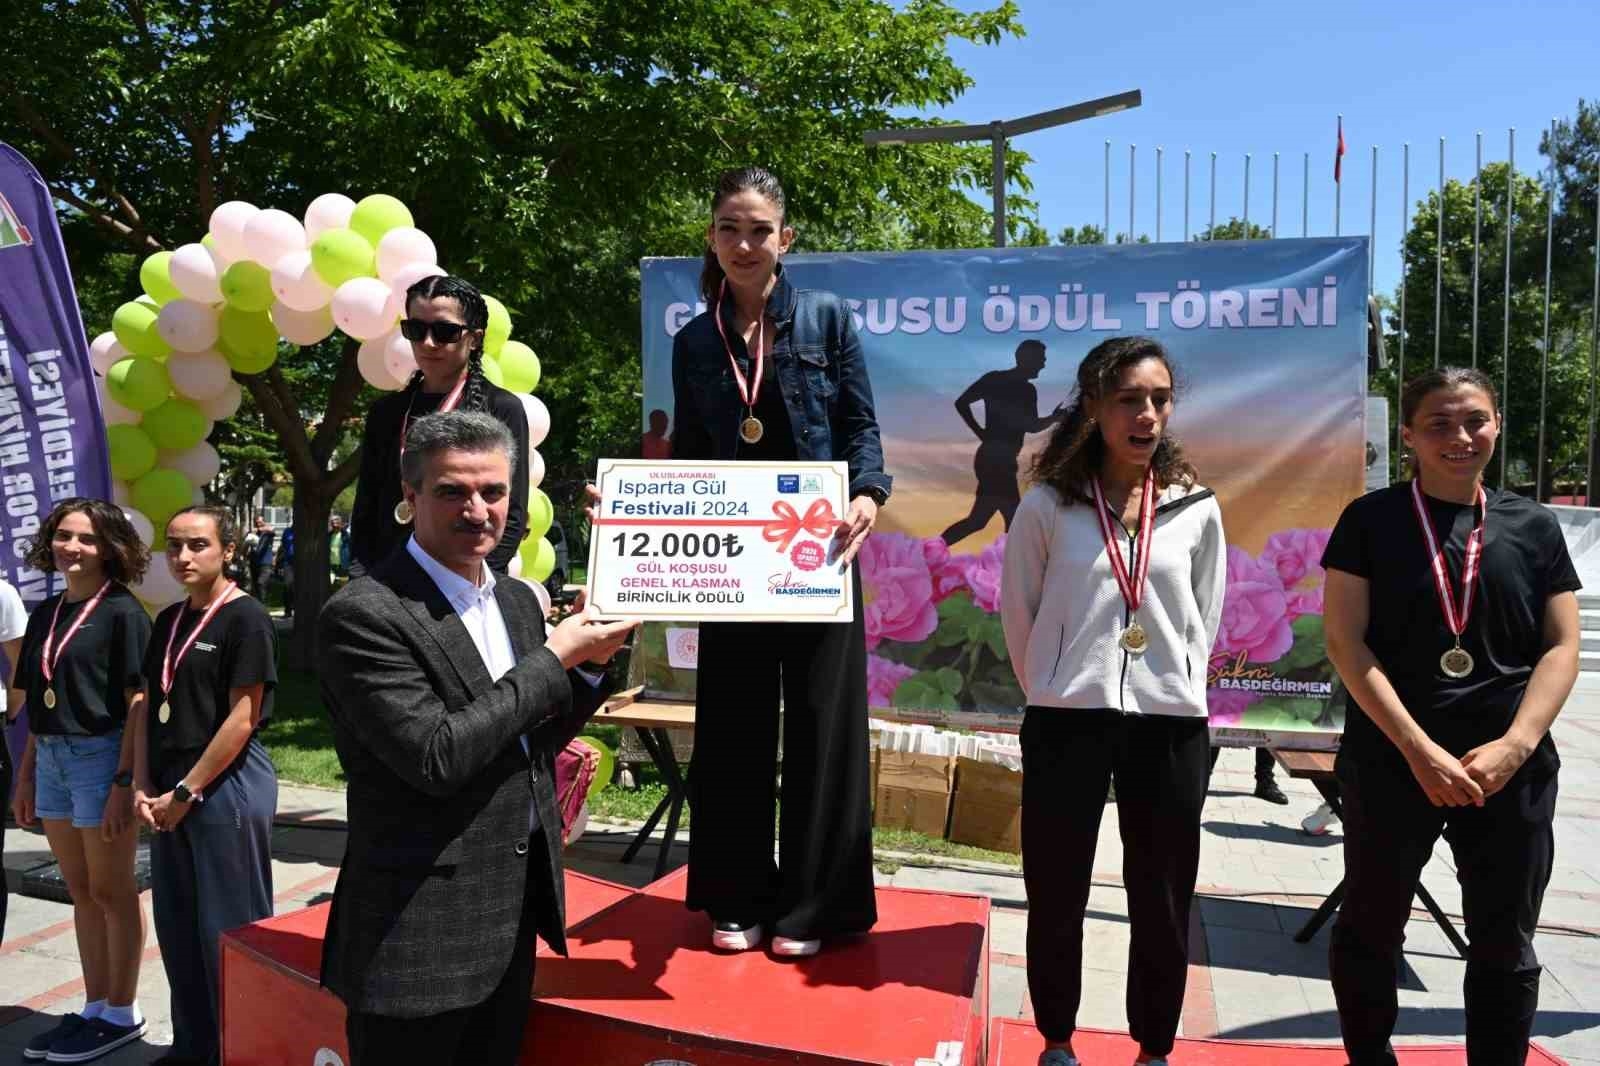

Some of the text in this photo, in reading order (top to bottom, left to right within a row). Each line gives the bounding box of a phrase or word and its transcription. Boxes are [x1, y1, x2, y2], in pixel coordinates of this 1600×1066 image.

[982, 283, 1122, 333] ÖDÜL
[1135, 275, 1337, 330] TÖRENİ
[618, 479, 726, 498] Isparta Gül
[611, 500, 749, 516] Festivali 2024
[612, 532, 744, 558] 12.000₺
[636, 561, 728, 576] GÜL KOŞUSU
[620, 577, 741, 588] GENEL KLASMAN
[616, 590, 745, 603] BİRİNCİLİK ÖDÜLÜ
[775, 587, 841, 596] BAŞDEĞİRMEN
[1219, 677, 1332, 693] BAŞDEĞİRMEN
